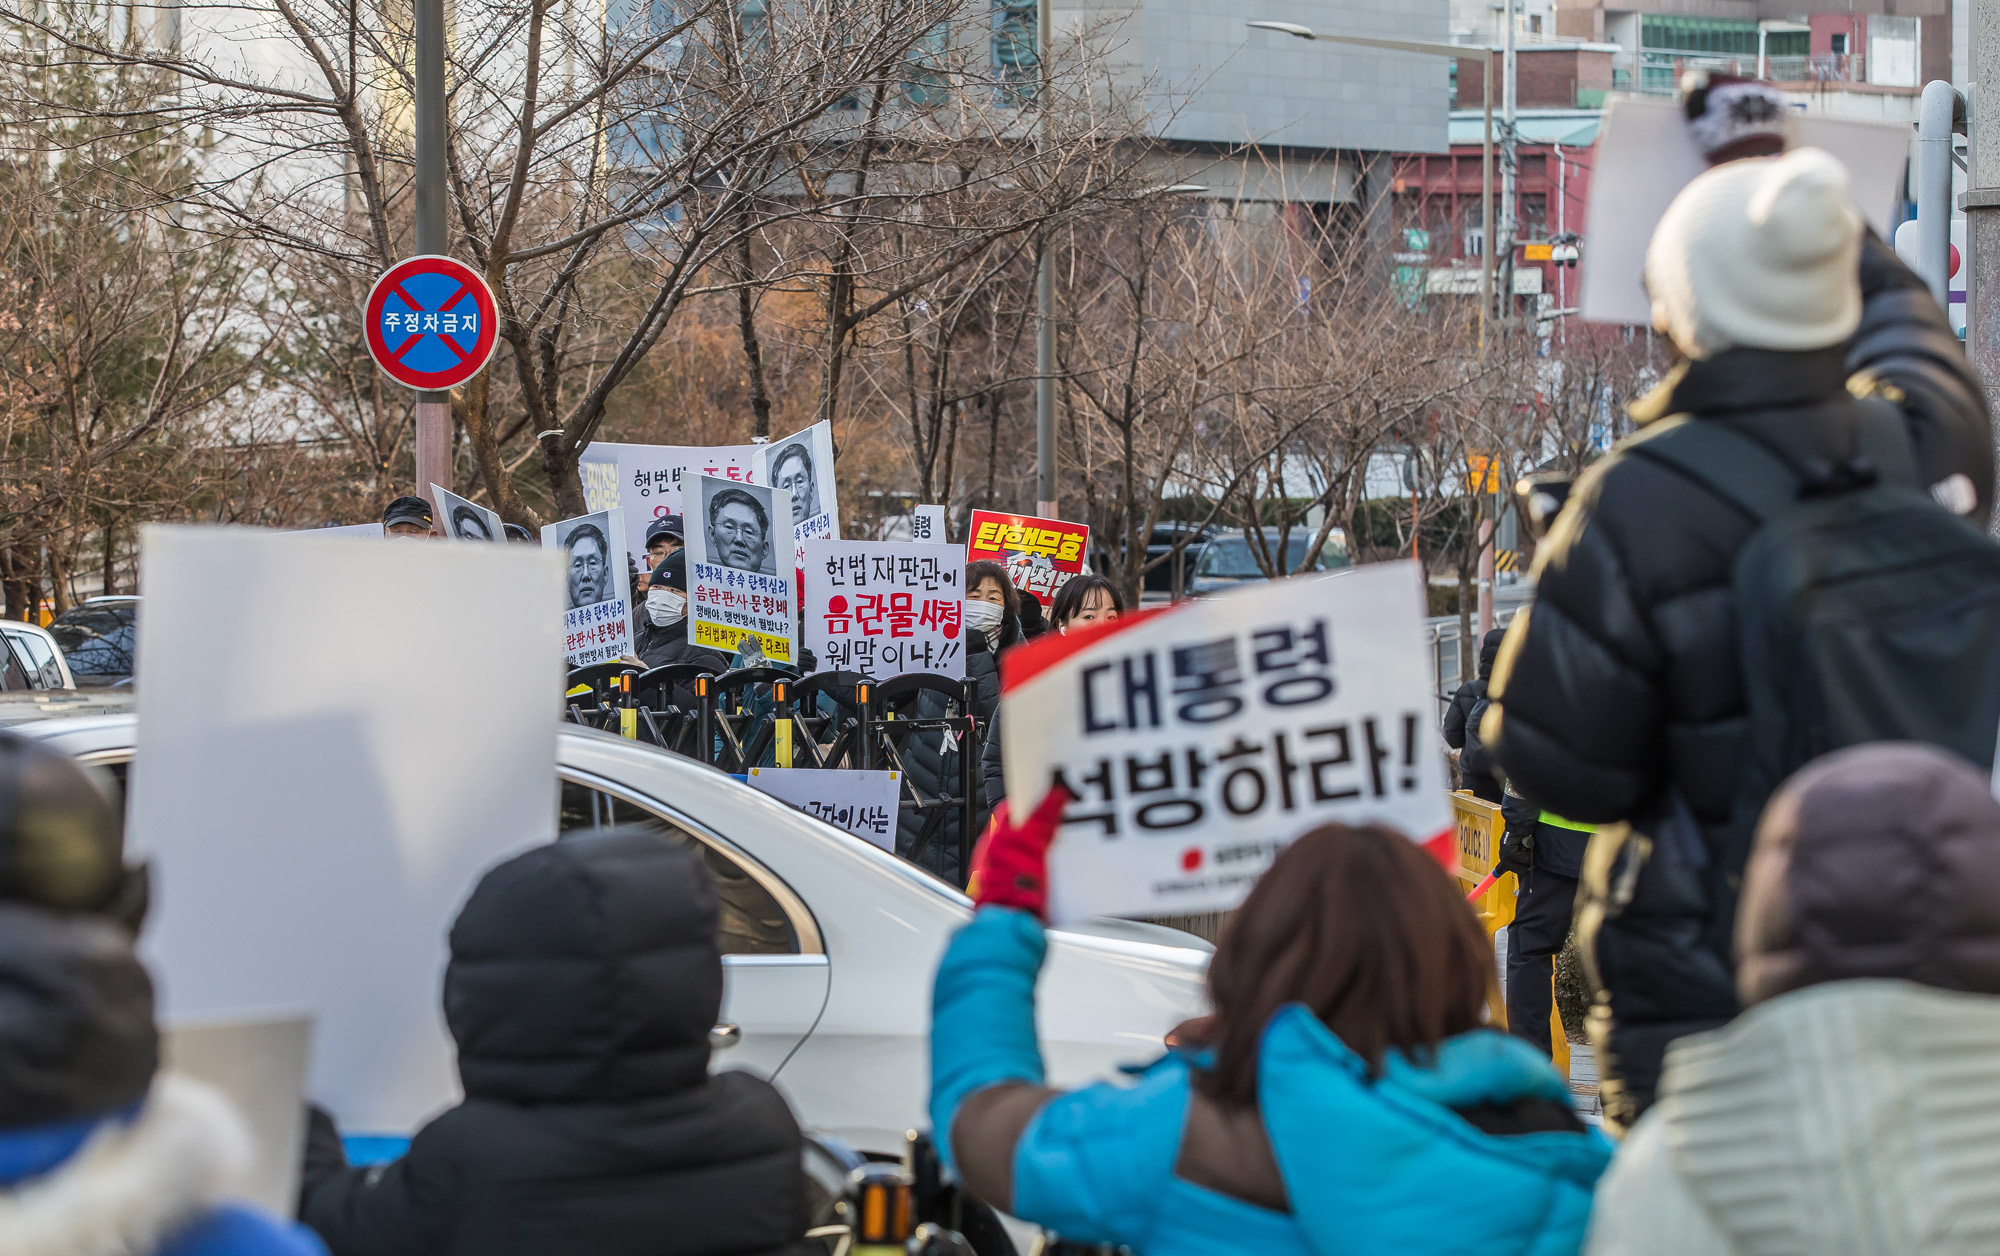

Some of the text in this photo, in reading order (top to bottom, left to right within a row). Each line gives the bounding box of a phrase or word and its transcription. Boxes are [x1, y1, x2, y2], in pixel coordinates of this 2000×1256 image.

[384, 312, 477, 333] 주정차금지
[974, 521, 1085, 562] 탄핵무효
[748, 574, 788, 597] 탄핵심리
[593, 599, 625, 622] 탄핵심리
[696, 624, 737, 646] 우리법회장
[765, 638, 790, 657] 다르네
[1081, 618, 1335, 736] 대통령
[1052, 713, 1418, 839] 석방하라!
[1460, 824, 1481, 859] POLICE
